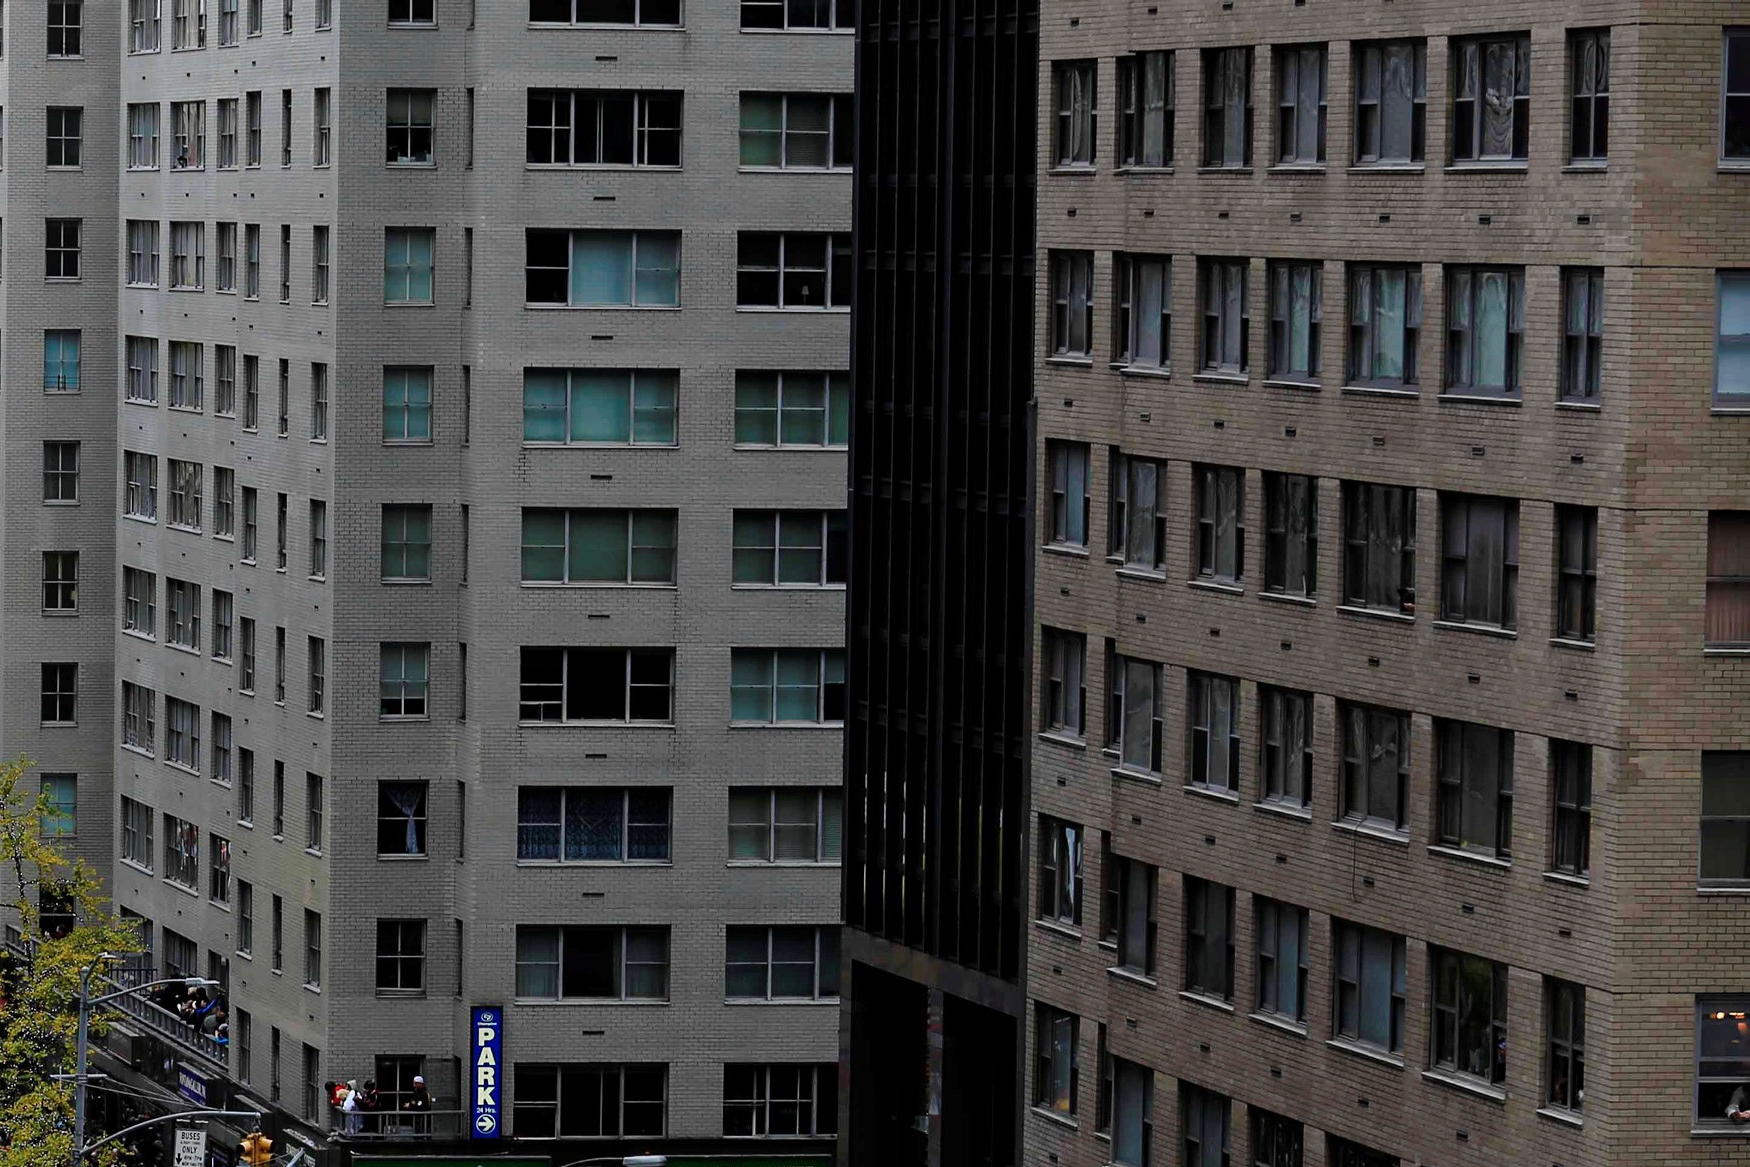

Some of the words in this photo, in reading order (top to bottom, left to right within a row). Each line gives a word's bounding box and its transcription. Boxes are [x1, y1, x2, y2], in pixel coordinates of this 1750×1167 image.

[476, 1027, 496, 1106] PARK
[182, 1132, 201, 1140] BUSES
[182, 1146, 198, 1154] ONLY
